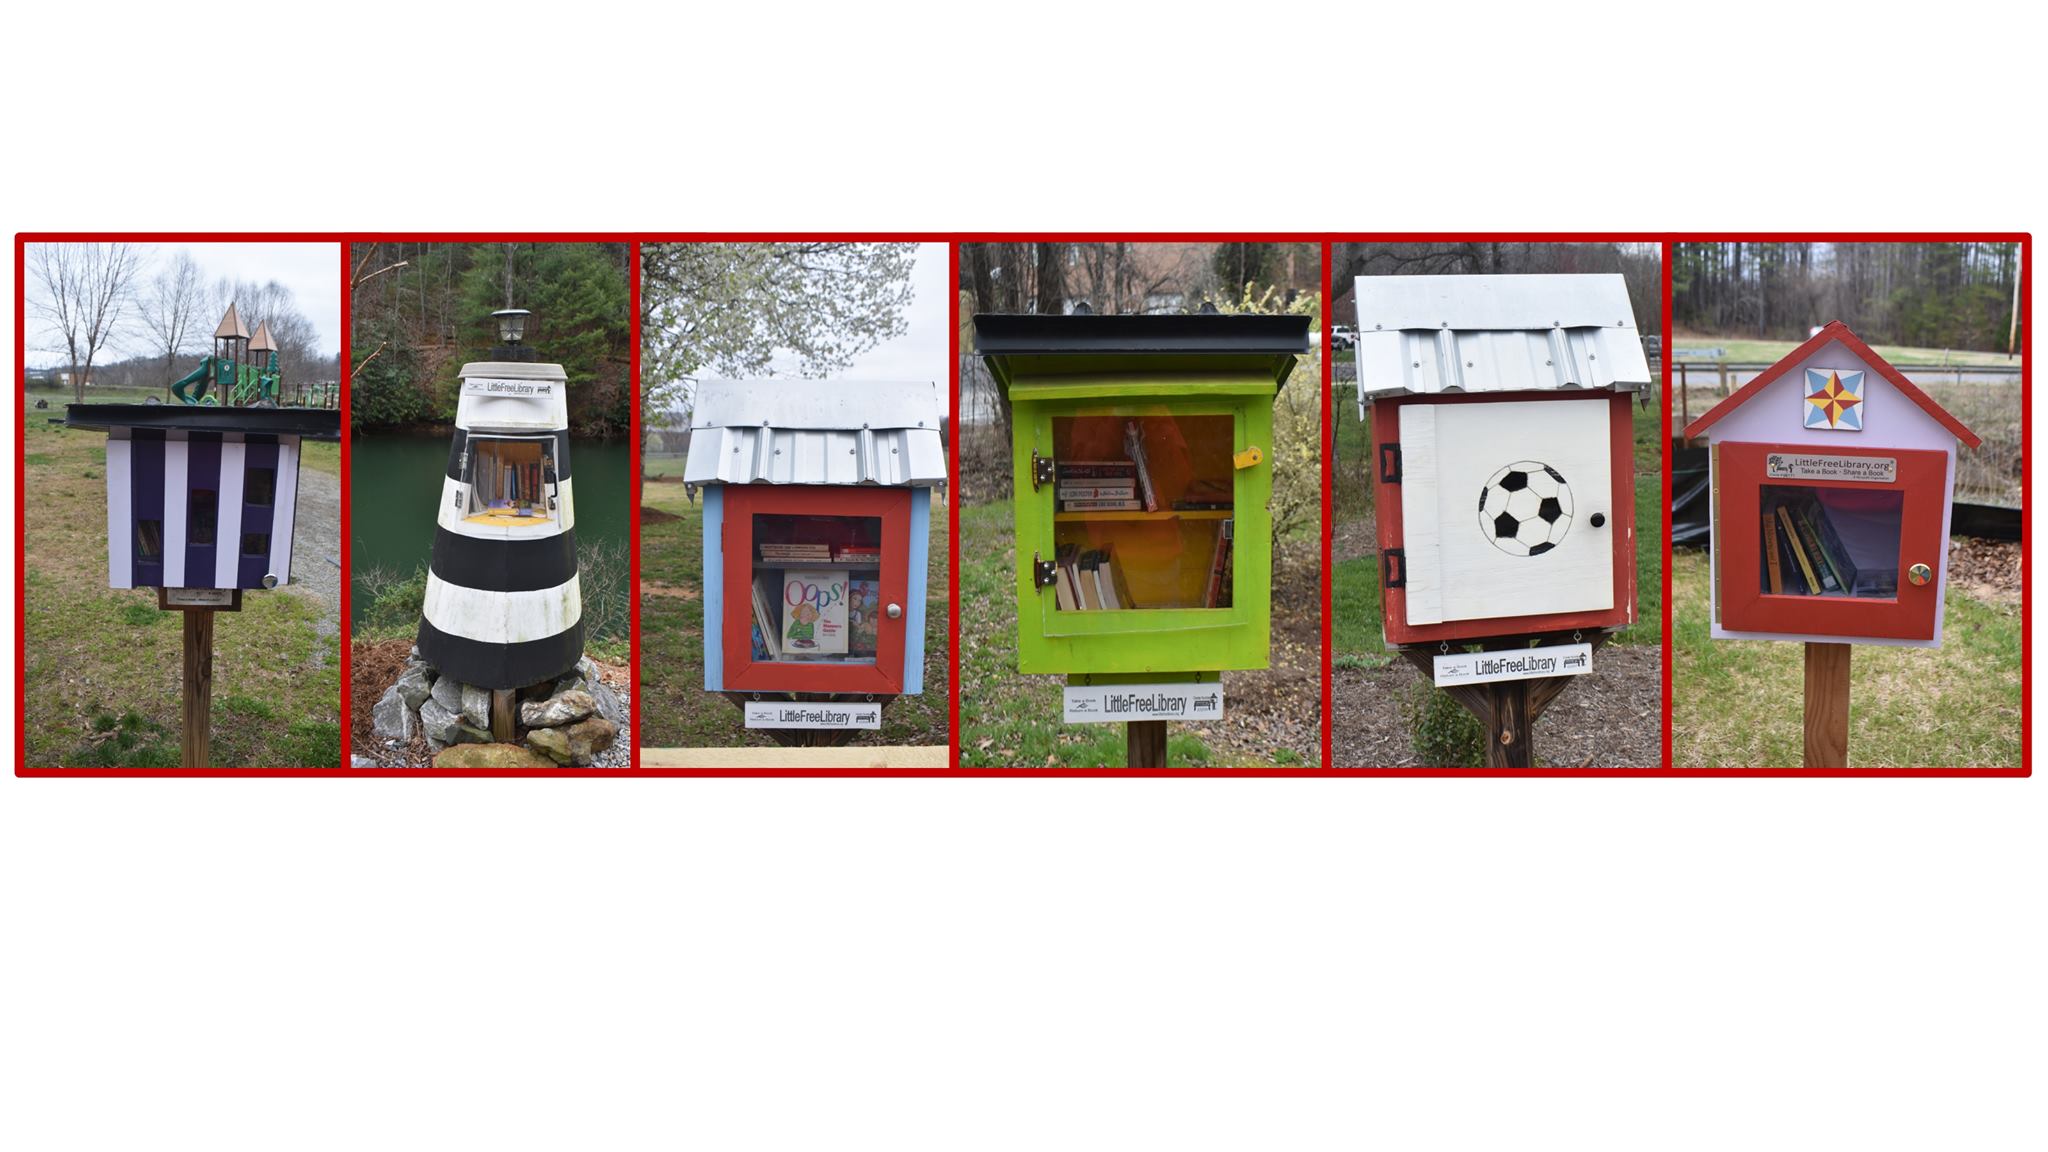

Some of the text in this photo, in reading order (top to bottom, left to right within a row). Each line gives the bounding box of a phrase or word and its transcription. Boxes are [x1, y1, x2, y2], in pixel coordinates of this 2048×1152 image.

[487, 382, 534, 394] LittleFreeLibrary
[1795, 458, 1890, 471] LittleFreeLibrary.org
[1821, 467, 1838, 475] Book
[785, 580, 848, 614] Oops!
[1475, 656, 1557, 676] LittleFreeLibrary
[1104, 693, 1187, 716] LittleFreeLibrary
[779, 709, 851, 726] LittleFreeLibrary
